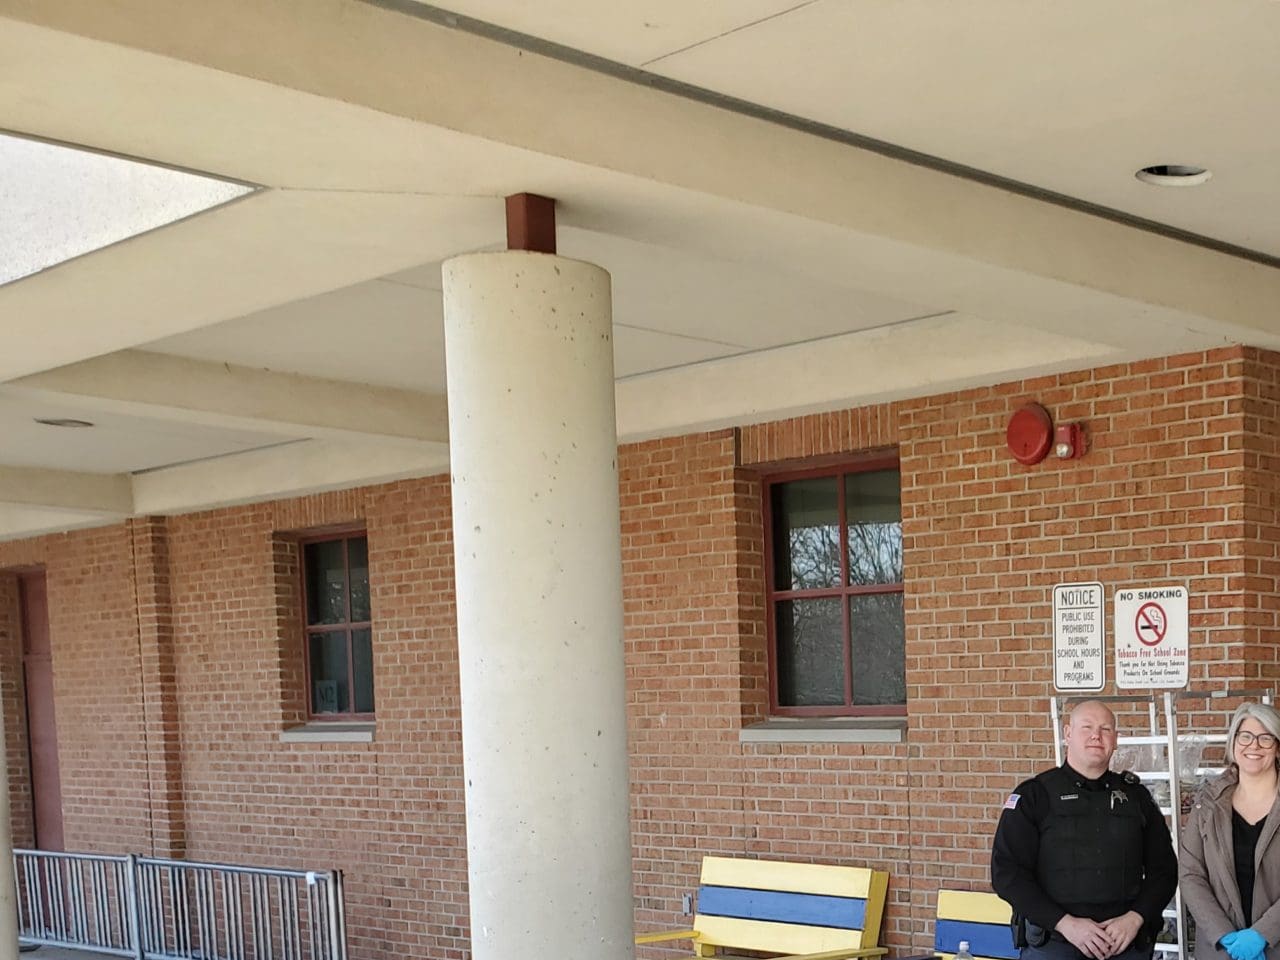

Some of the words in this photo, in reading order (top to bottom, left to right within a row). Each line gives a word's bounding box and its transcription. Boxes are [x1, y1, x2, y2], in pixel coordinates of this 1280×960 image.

[1061, 590, 1095, 606] NOTICE
[1120, 593, 1133, 601] NO
[1138, 590, 1182, 600] SMOKING
[1062, 612, 1081, 622] PUBLIC
[1083, 612, 1095, 621] USE
[1062, 624, 1095, 634] PROHIBITED
[1068, 637, 1089, 646] DURING
[1057, 649, 1079, 658] SCHOOL
[1081, 648, 1101, 658] HOURS
[1117, 648, 1137, 659] Tobacco
[1139, 648, 1151, 658] Free
[1154, 647, 1171, 657] School
[1173, 647, 1186, 657] Zone
[1073, 661, 1085, 669] AND
[1063, 672, 1094, 682] PROGRAMS
